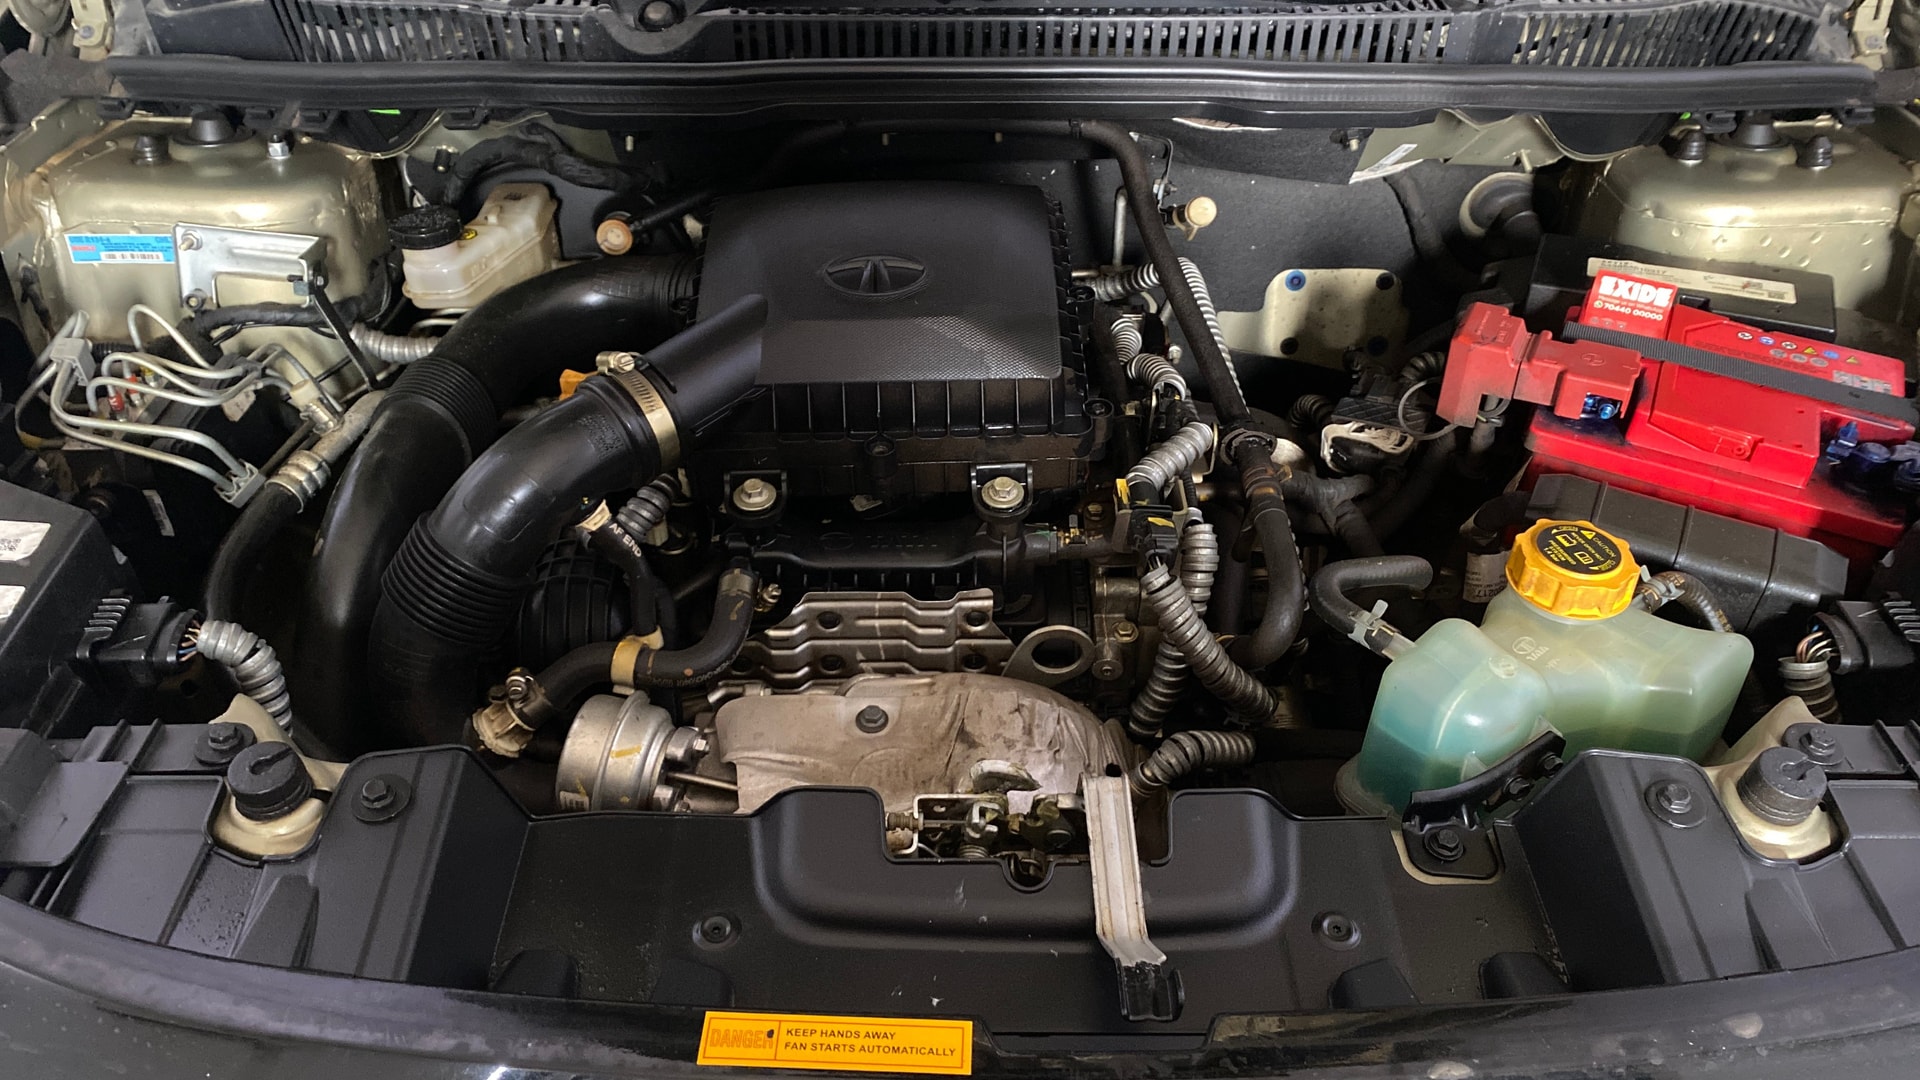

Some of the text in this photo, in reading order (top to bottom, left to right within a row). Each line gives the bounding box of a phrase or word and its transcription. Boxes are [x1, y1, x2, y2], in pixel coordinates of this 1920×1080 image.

[1599, 275, 1673, 307] EXIDE
[1603, 302, 1663, 321] 70440 00000
[1593, 537, 1616, 557] CAUTION
[709, 1028, 774, 1049] DANGER
[786, 1028, 896, 1040] KEEP HANDS AWAY
[784, 1042, 956, 1057] FAN STARTS AUTOMATICALLY
